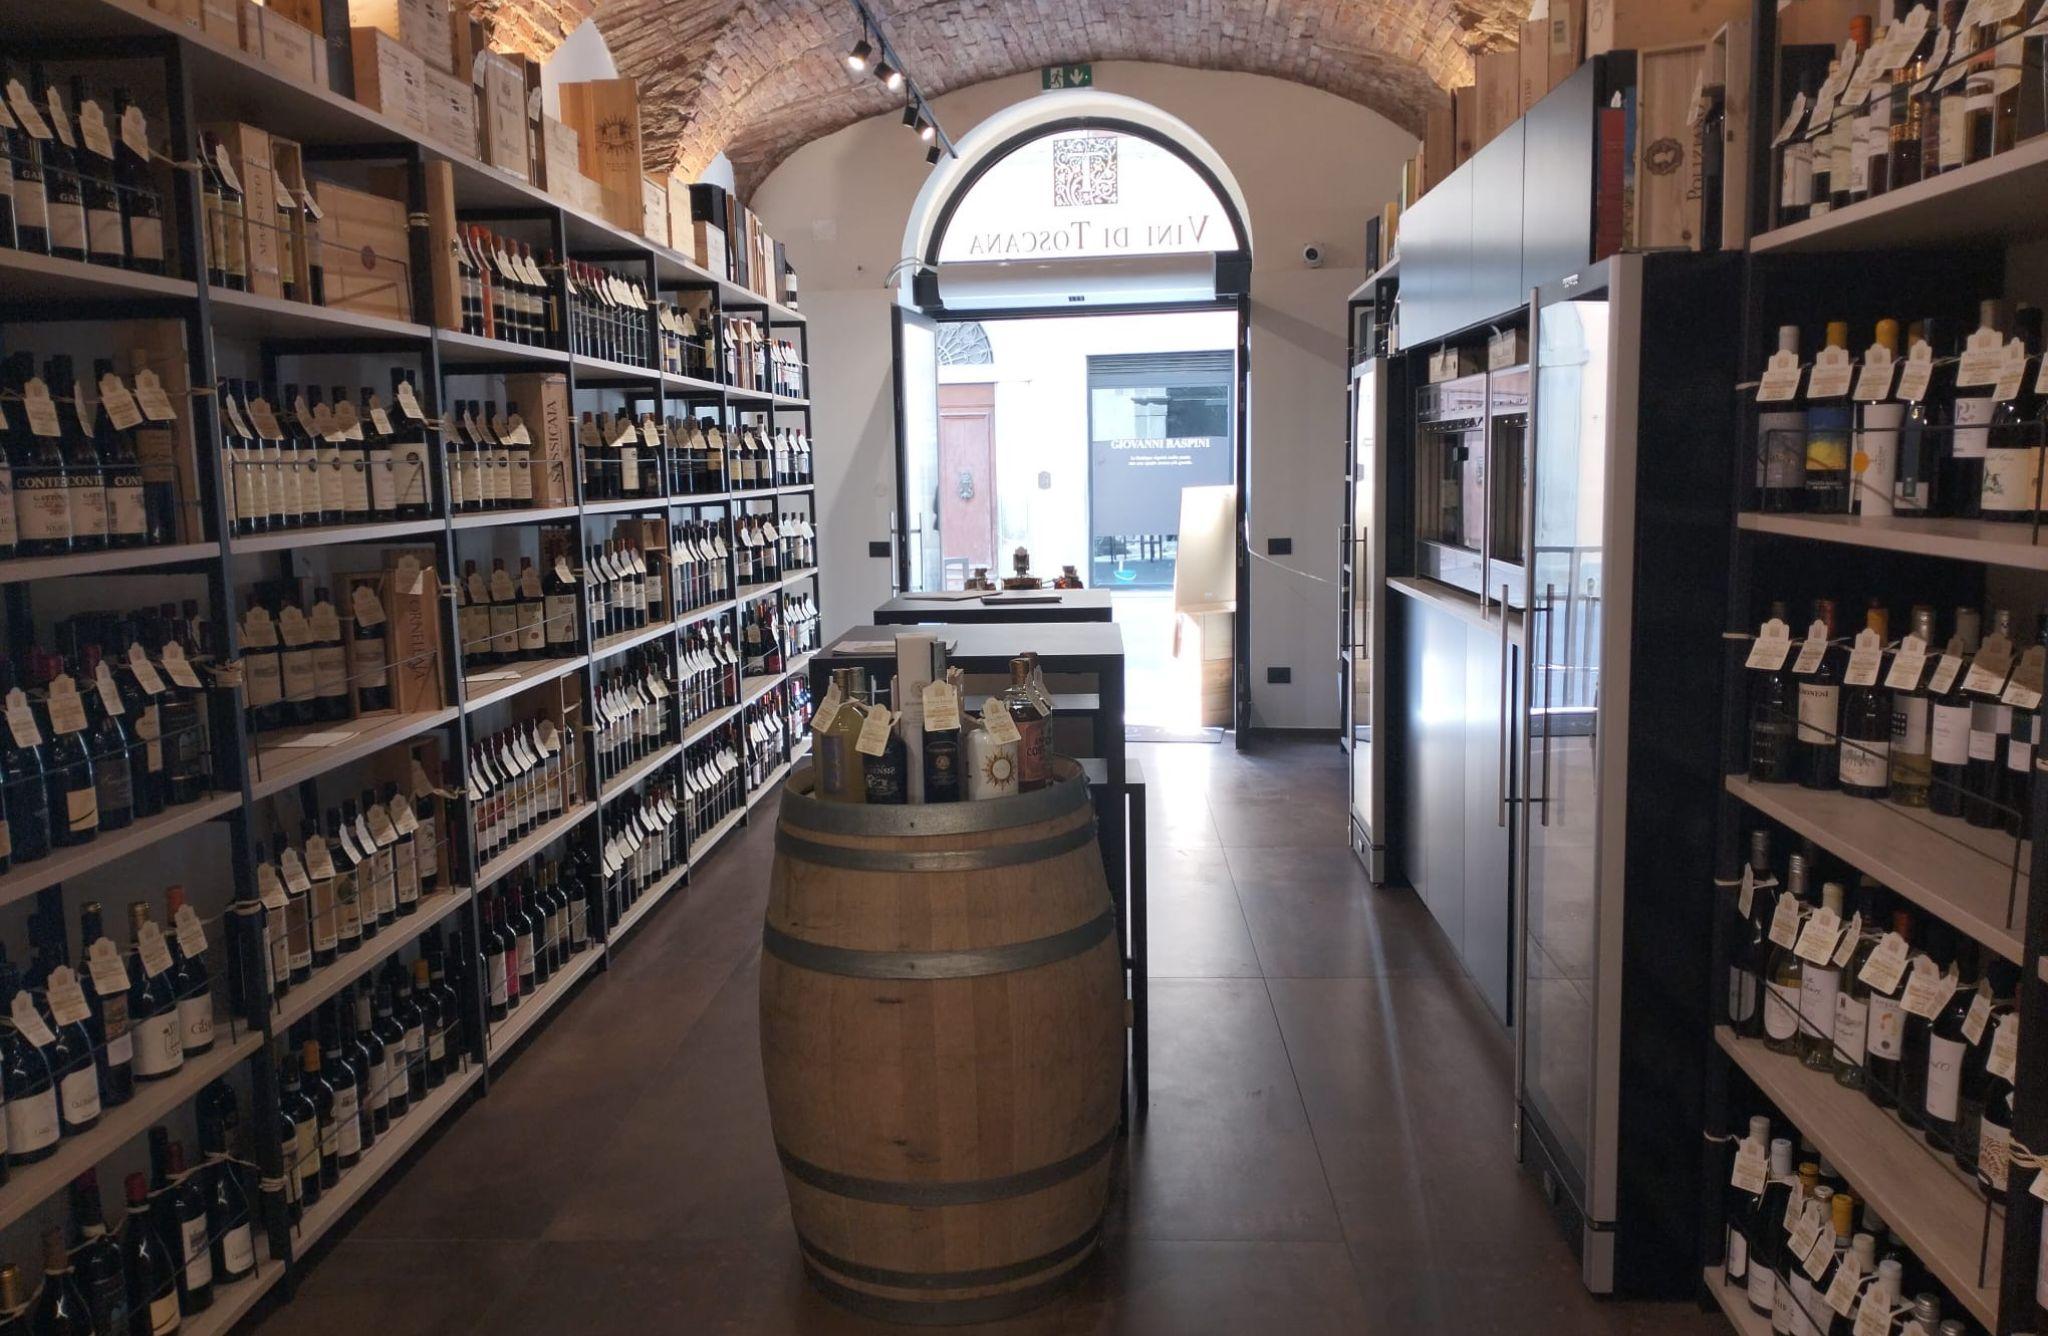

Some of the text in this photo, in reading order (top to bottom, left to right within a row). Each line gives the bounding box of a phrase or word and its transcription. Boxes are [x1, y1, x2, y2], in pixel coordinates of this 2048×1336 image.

[253, 174, 268, 256] MASSETO
[546, 400, 562, 484] SASSICAIA
[1110, 438, 1163, 450] GIOVANNI
